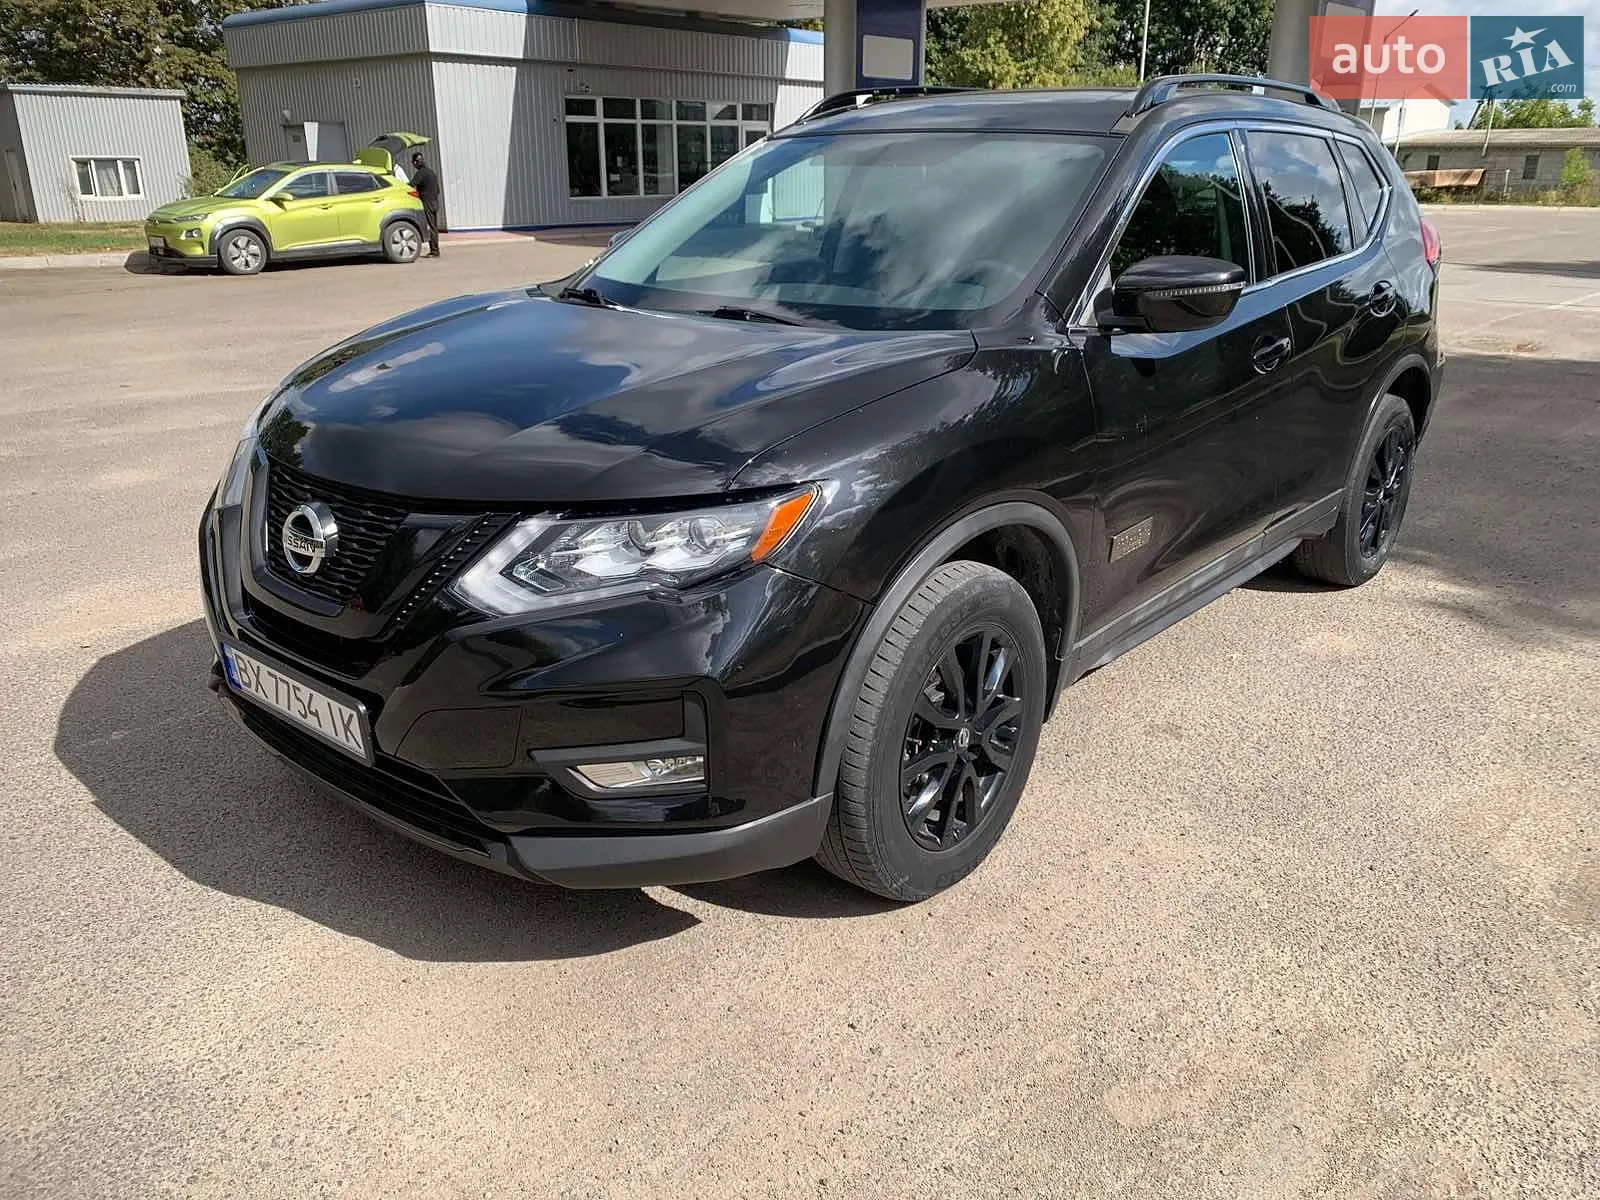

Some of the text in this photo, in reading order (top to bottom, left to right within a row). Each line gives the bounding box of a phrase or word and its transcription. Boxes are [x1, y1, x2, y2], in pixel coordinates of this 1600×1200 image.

[285, 534, 316, 553] SSAN
[234, 653, 362, 749] BX 7754 IK
